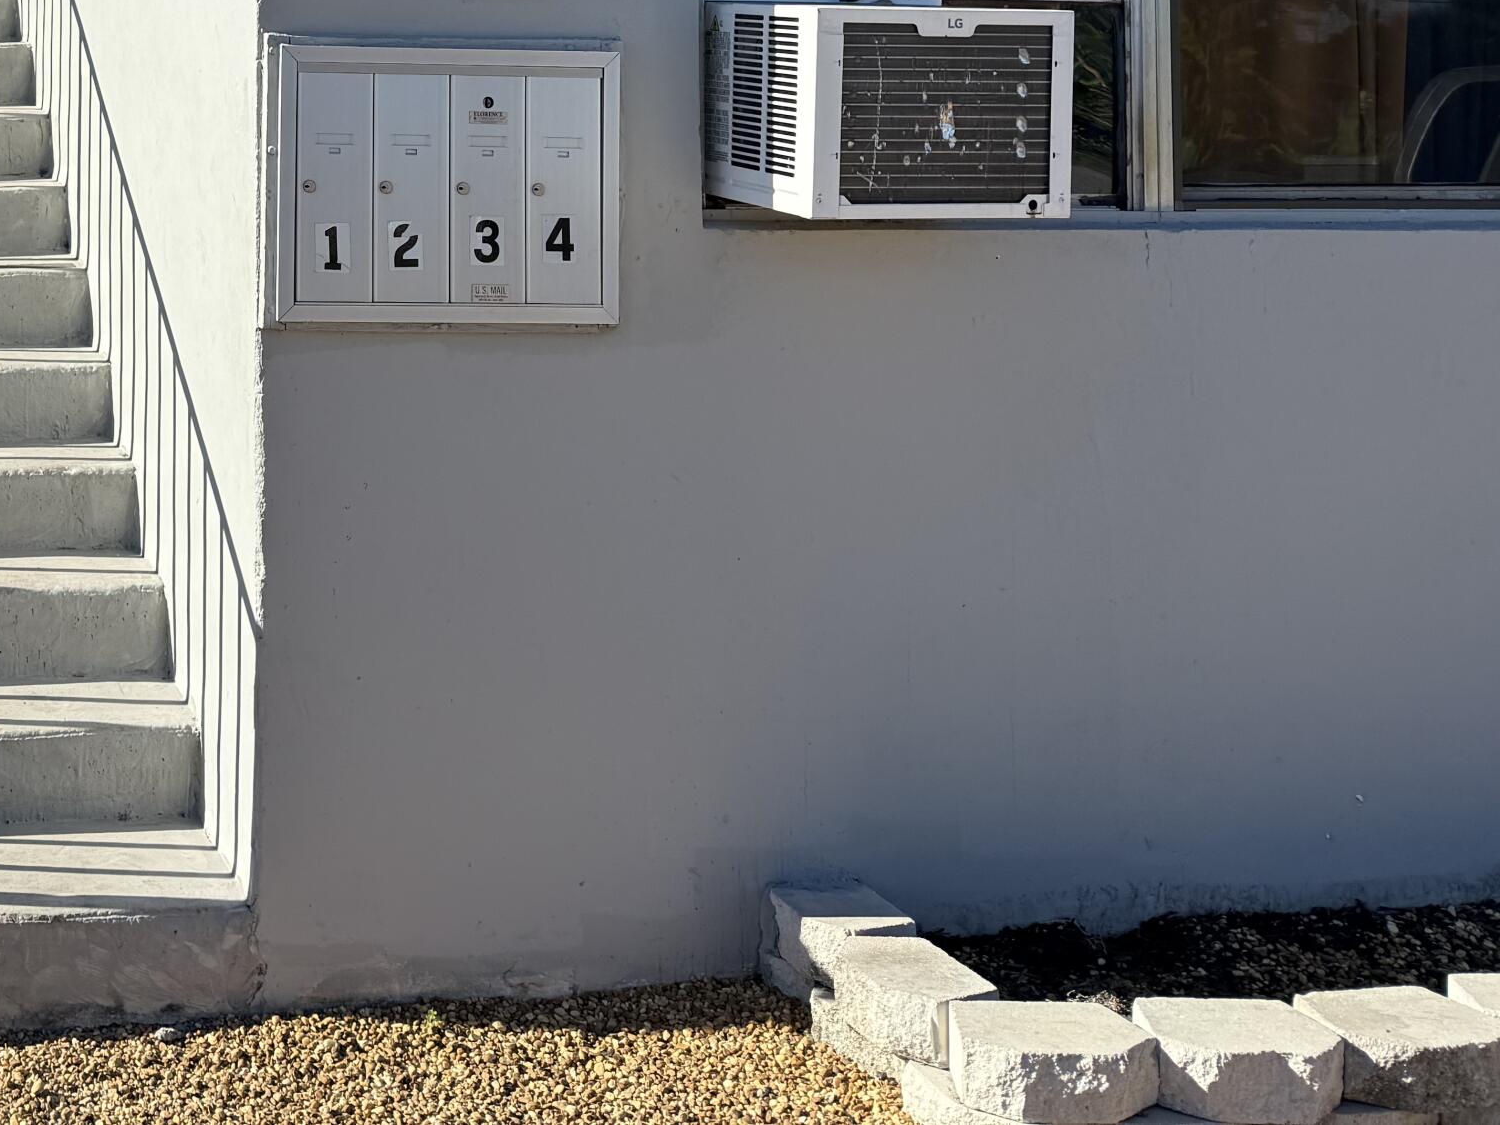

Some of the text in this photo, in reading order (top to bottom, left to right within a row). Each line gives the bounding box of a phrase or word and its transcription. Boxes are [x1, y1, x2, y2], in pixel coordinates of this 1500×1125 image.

[948, 18, 963, 29] LG
[324, 226, 342, 270] 1
[393, 224, 419, 268] 2
[474, 219, 500, 263] 3
[545, 217, 574, 261] 4
[490, 286, 507, 295] MAIL
